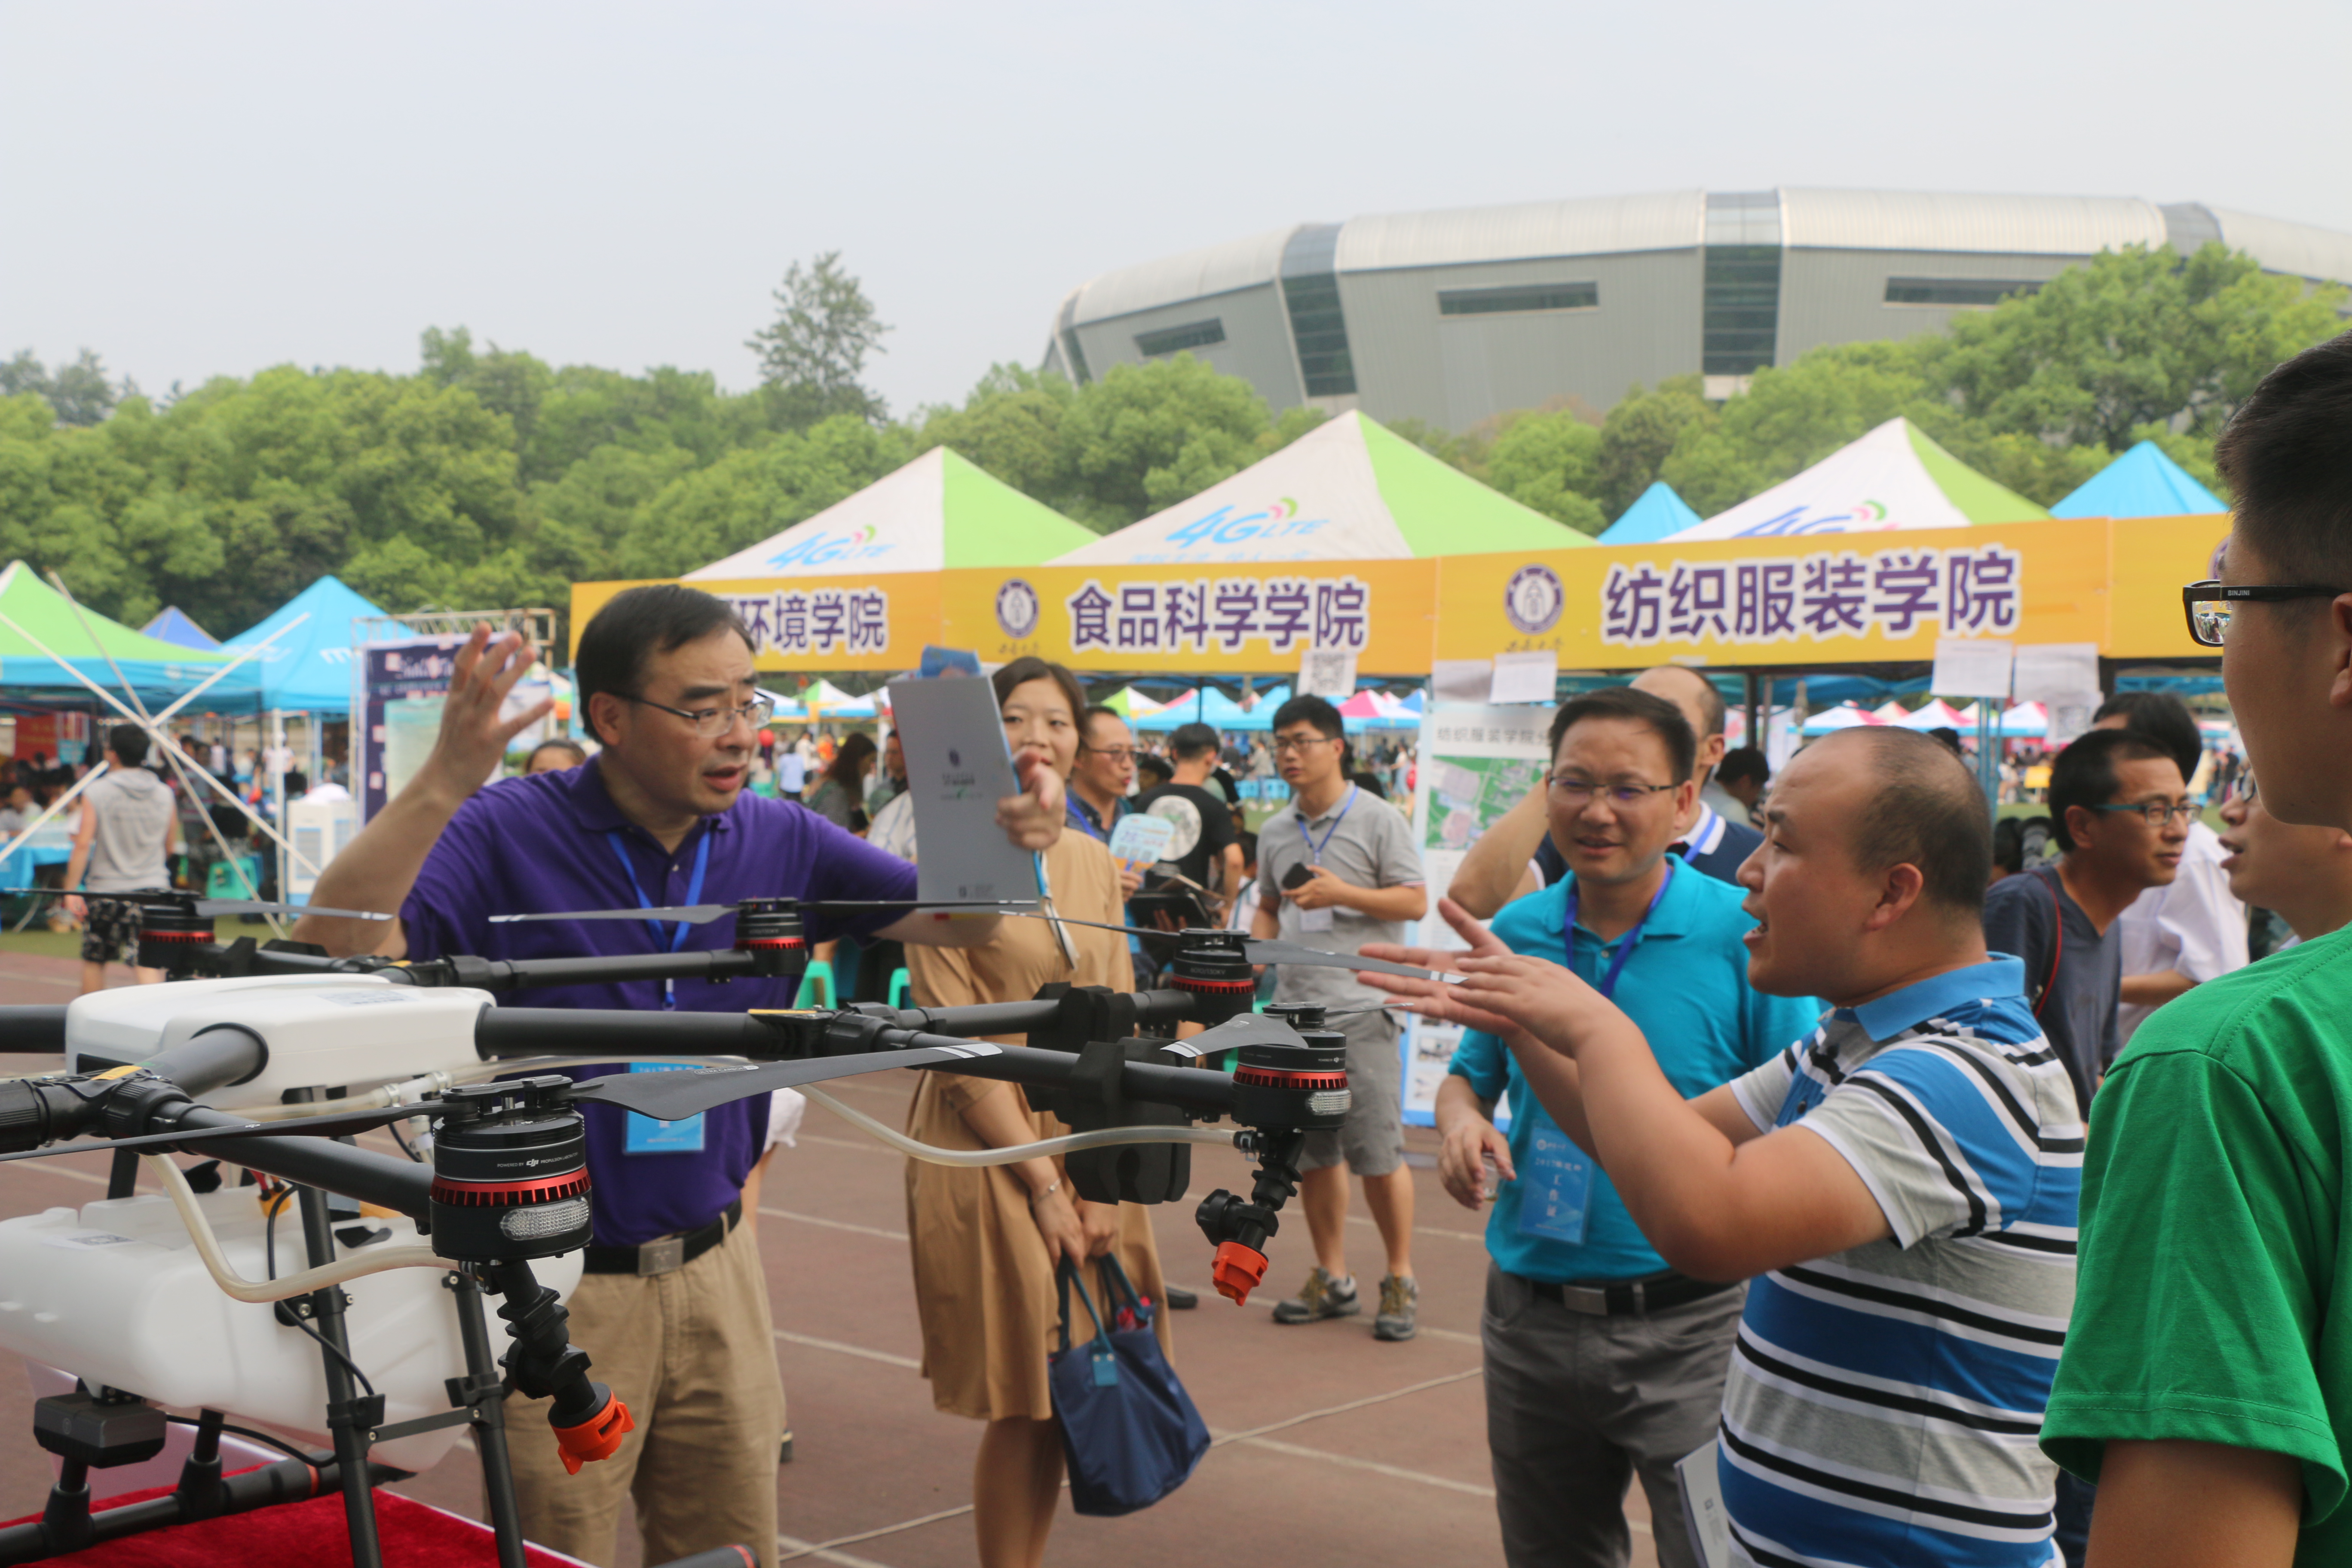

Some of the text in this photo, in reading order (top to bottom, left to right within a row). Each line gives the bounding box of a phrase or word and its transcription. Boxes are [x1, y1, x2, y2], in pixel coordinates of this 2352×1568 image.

[766, 531, 851, 571] 4G
[1165, 505, 1331, 549] 4G LTE
[726, 593, 885, 648] 环境学院
[1069, 580, 1366, 648] 食品科学学院
[1604, 551, 2016, 640] 纺织服装学院
